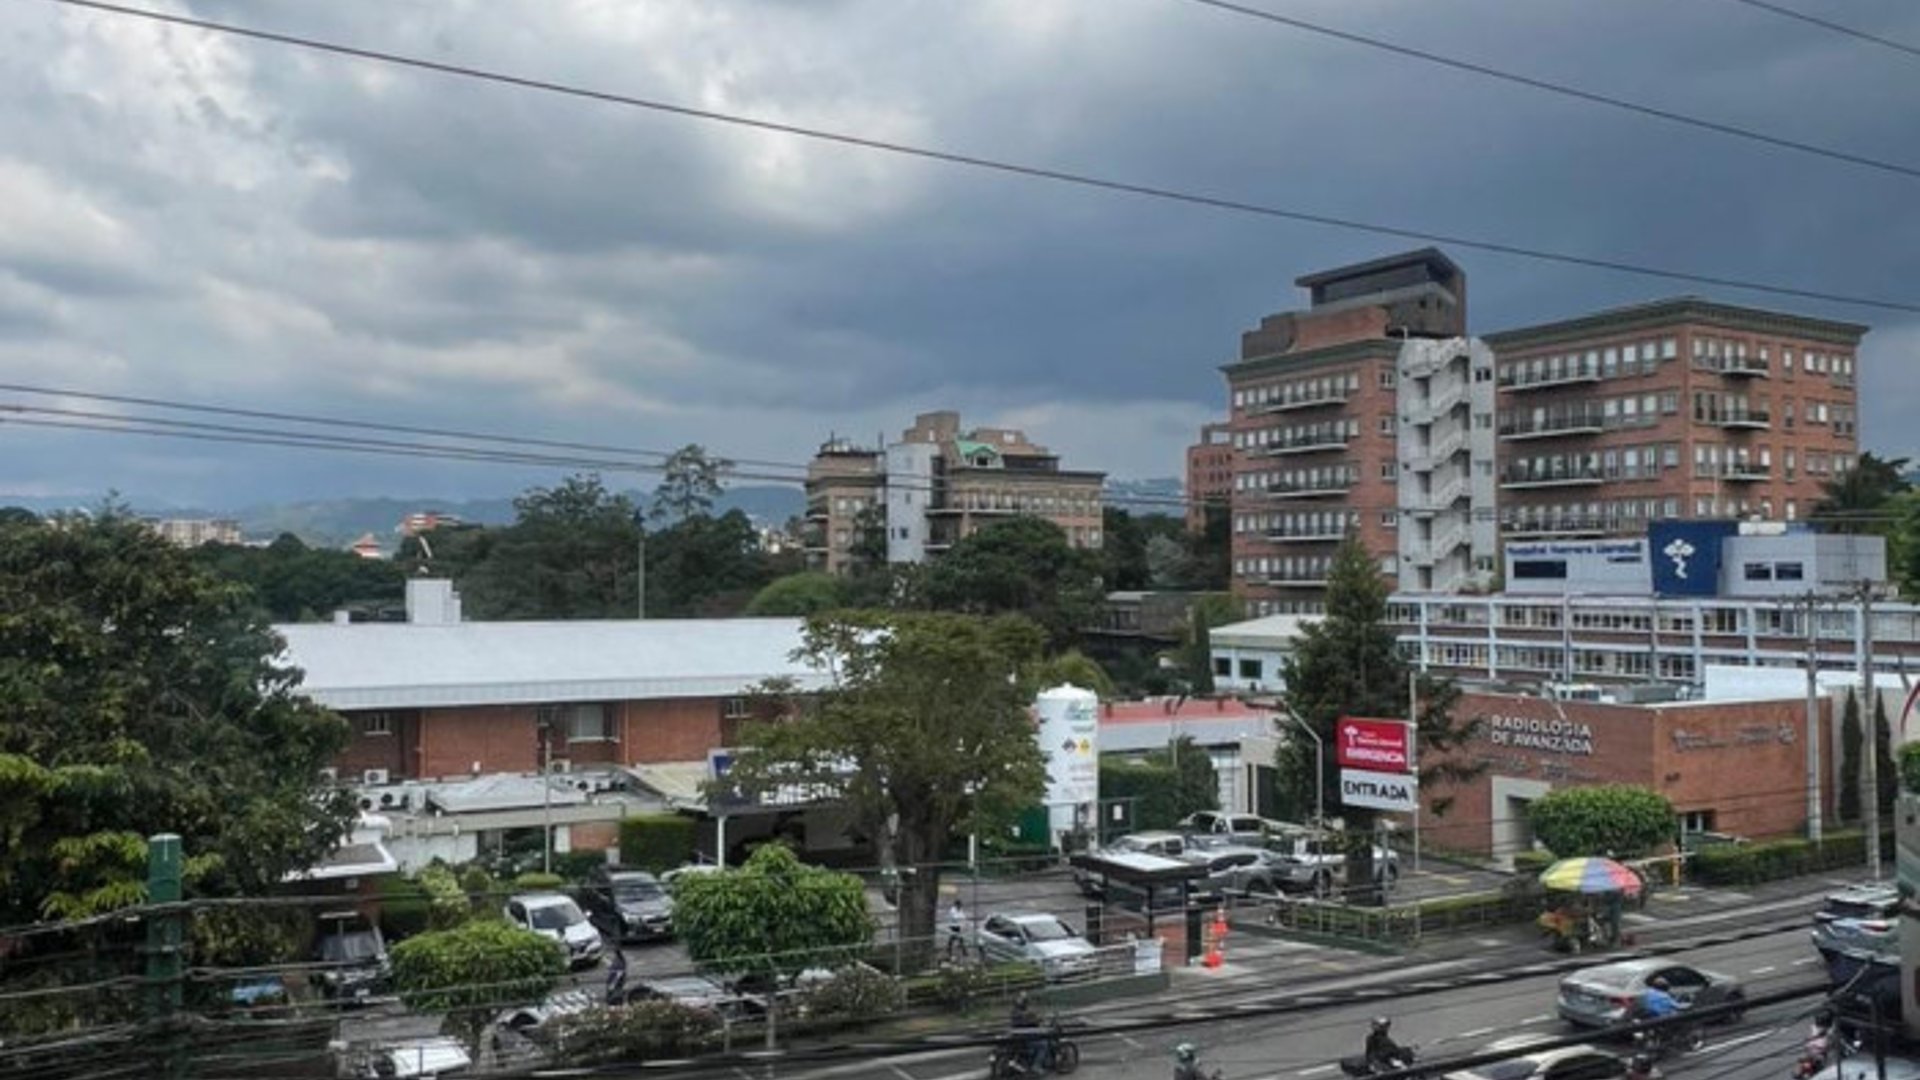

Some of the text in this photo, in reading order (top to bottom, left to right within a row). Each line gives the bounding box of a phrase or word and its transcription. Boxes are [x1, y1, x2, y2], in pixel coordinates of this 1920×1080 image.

[1491, 730, 1593, 754] DE AVANZADA
[1343, 780, 1410, 801] ENTRADA
